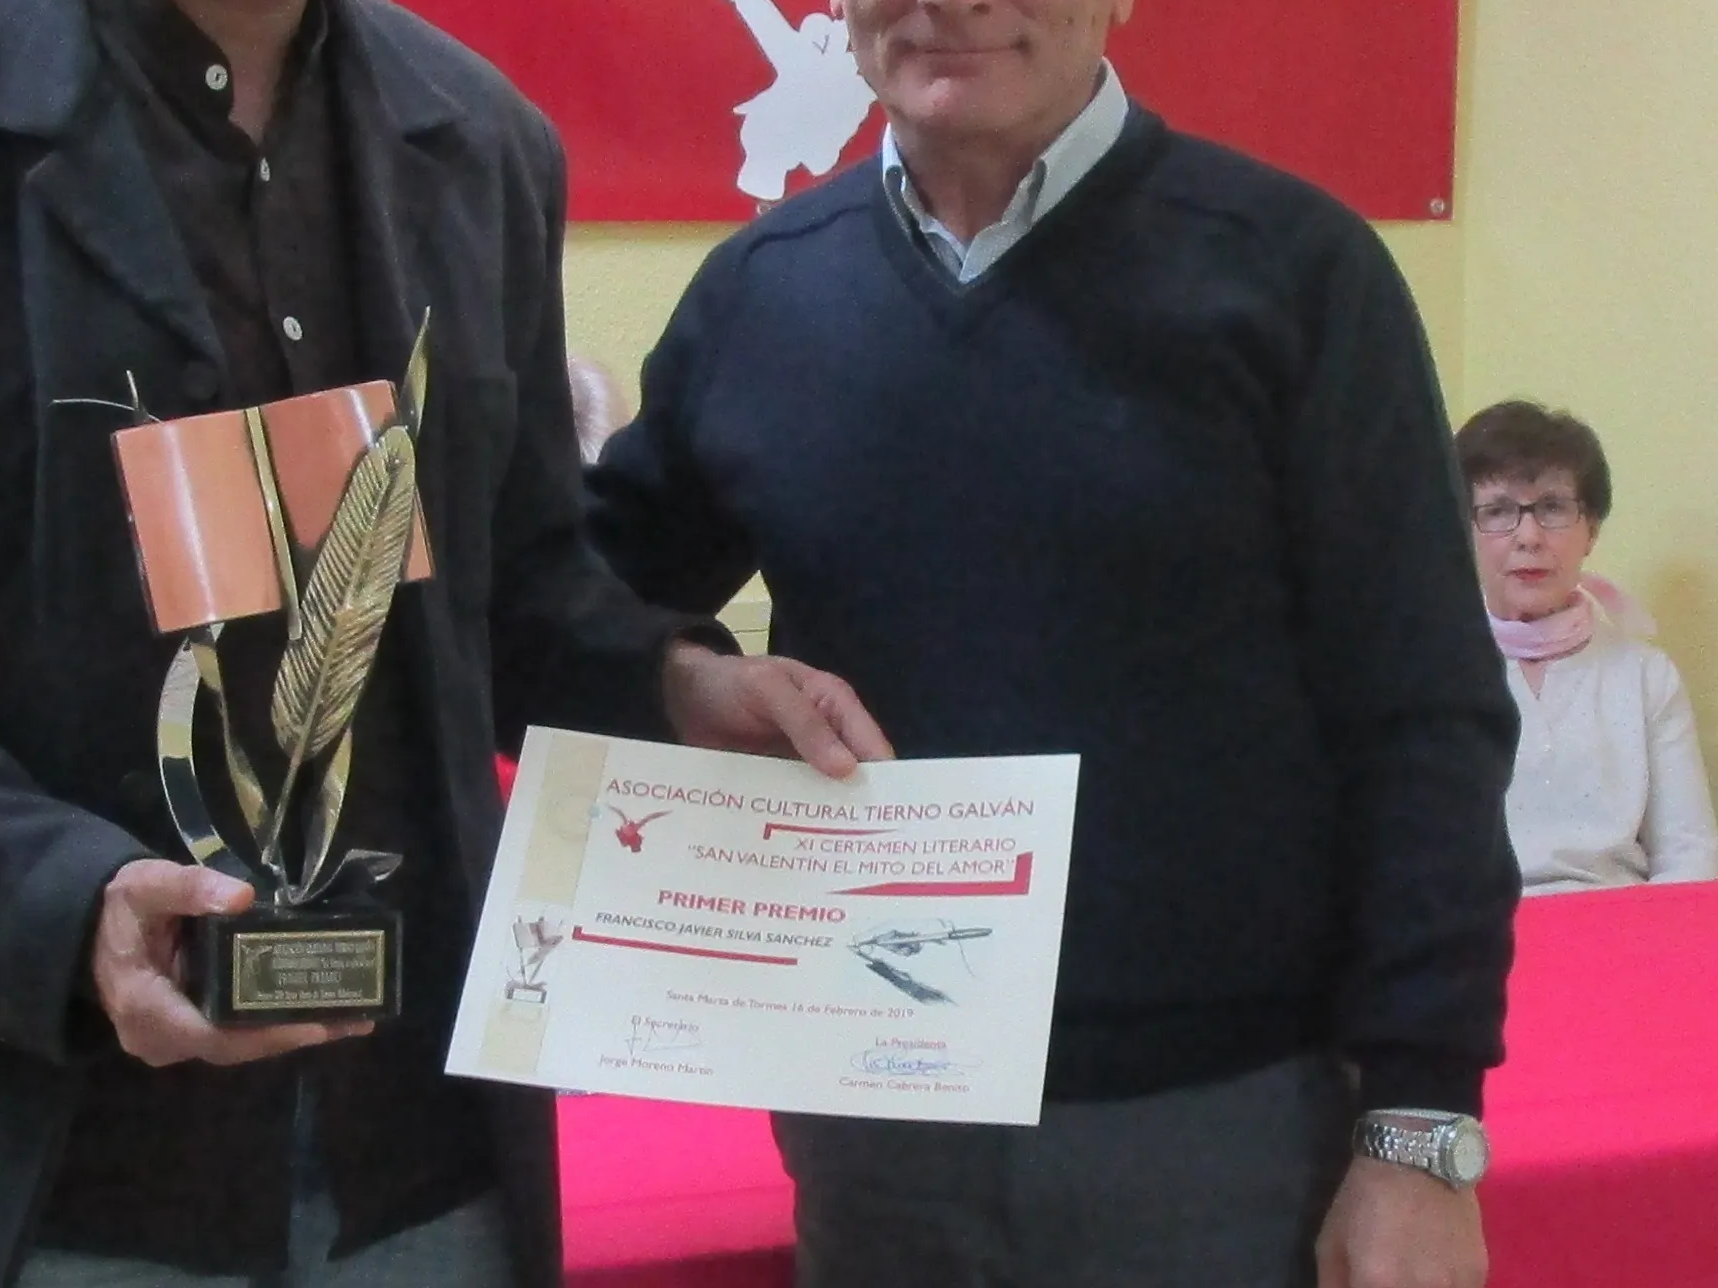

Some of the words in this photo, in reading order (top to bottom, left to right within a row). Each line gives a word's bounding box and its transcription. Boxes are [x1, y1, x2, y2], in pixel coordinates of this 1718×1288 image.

[605, 777, 744, 811] ASOCIACIÓN
[750, 796, 859, 822] CULTURAL
[863, 803, 942, 822] TIERNO
[946, 795, 1034, 820] GALVÁN
[794, 837, 813, 852] XI
[819, 838, 917, 854] CERTAMEN
[922, 837, 1016, 853] LITERARIO
[833, 859, 853, 875] EL
[857, 859, 906, 876] MITO
[911, 860, 945, 876] DEL
[657, 889, 747, 916] PRIMER
[752, 900, 847, 924] PREMIO
[595, 911, 677, 932] FRANCISCO
[678, 923, 723, 939] JAVIER
[726, 928, 763, 942] SILVA
